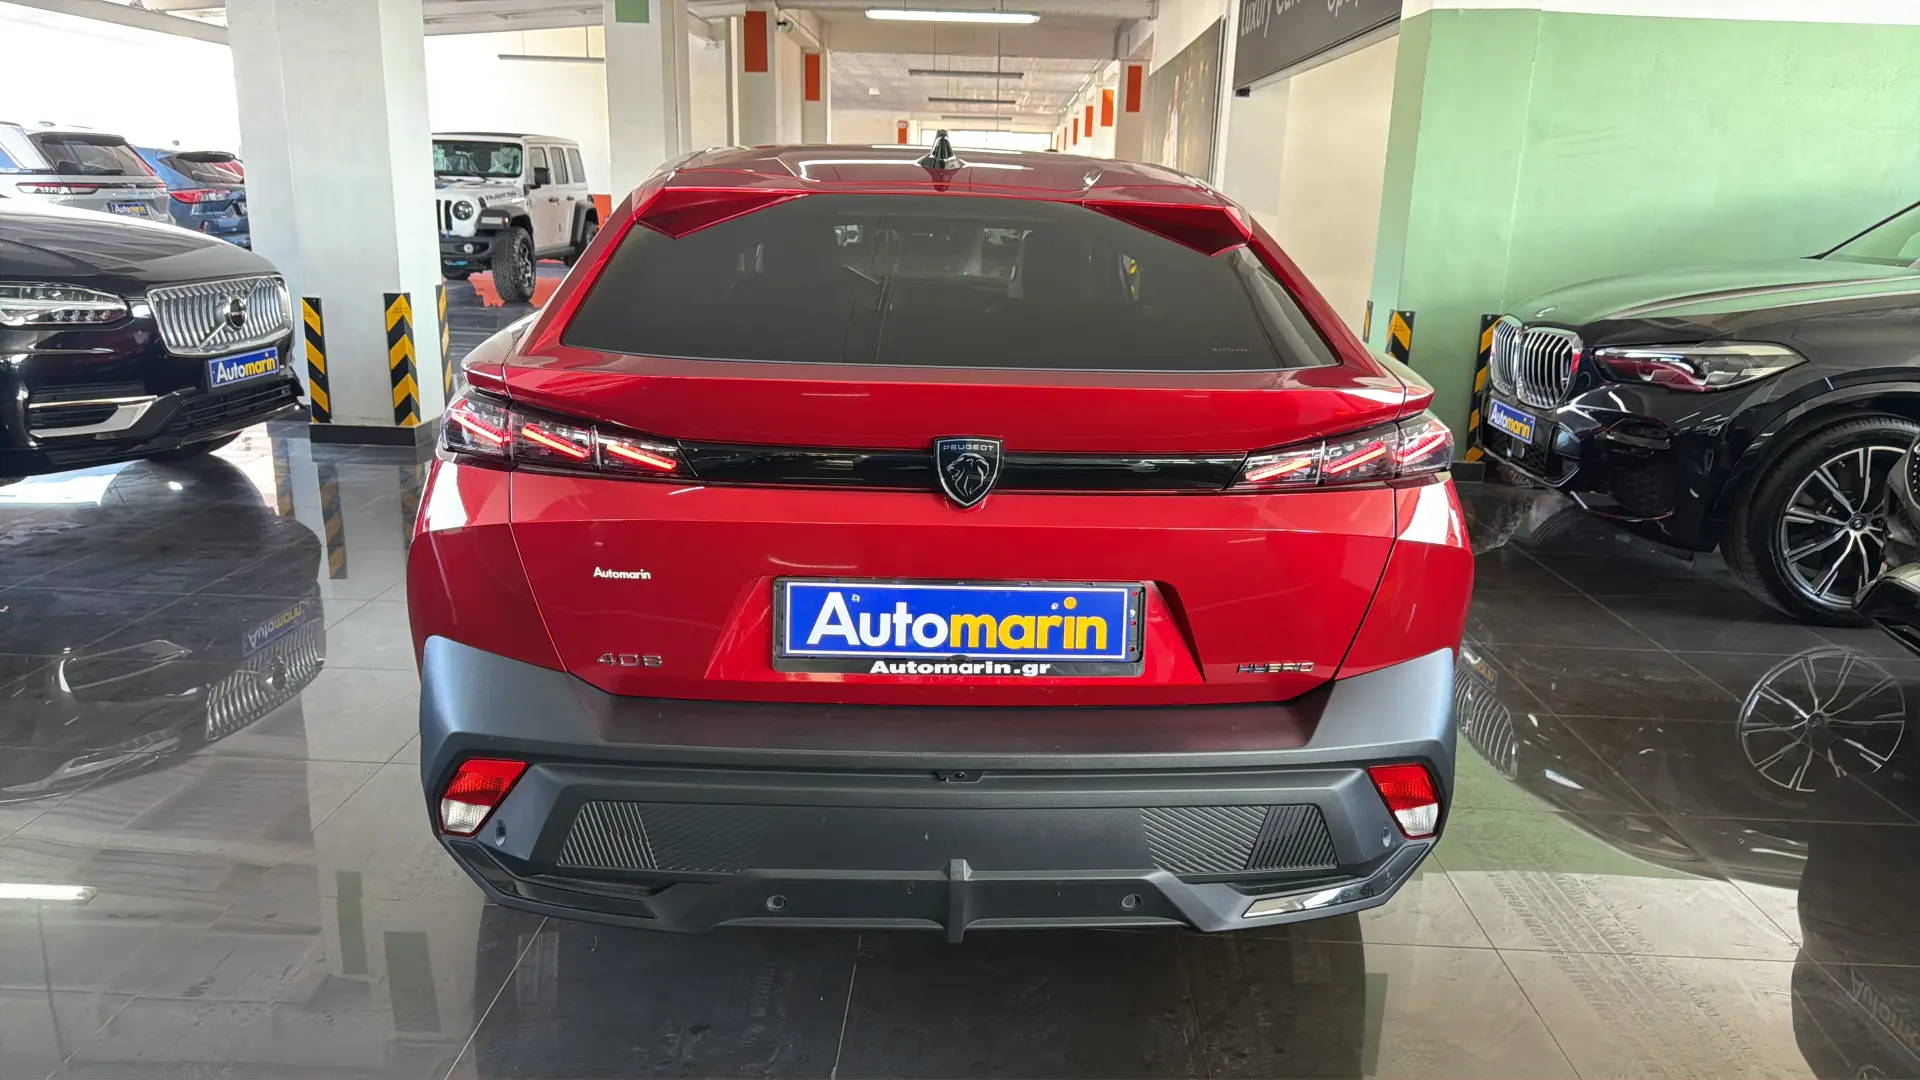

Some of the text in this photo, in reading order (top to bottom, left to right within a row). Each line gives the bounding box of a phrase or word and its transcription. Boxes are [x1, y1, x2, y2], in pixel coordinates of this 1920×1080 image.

[1241, 0, 1272, 38] Luxury
[216, 352, 276, 383] Automarin
[1490, 403, 1531, 439] Automarin
[593, 566, 652, 580] Automarin
[806, 591, 1108, 650] Automarin
[597, 653, 662, 667] 408
[870, 660, 1051, 677] Automarin.gr
[1236, 662, 1314, 674] HYBRID
